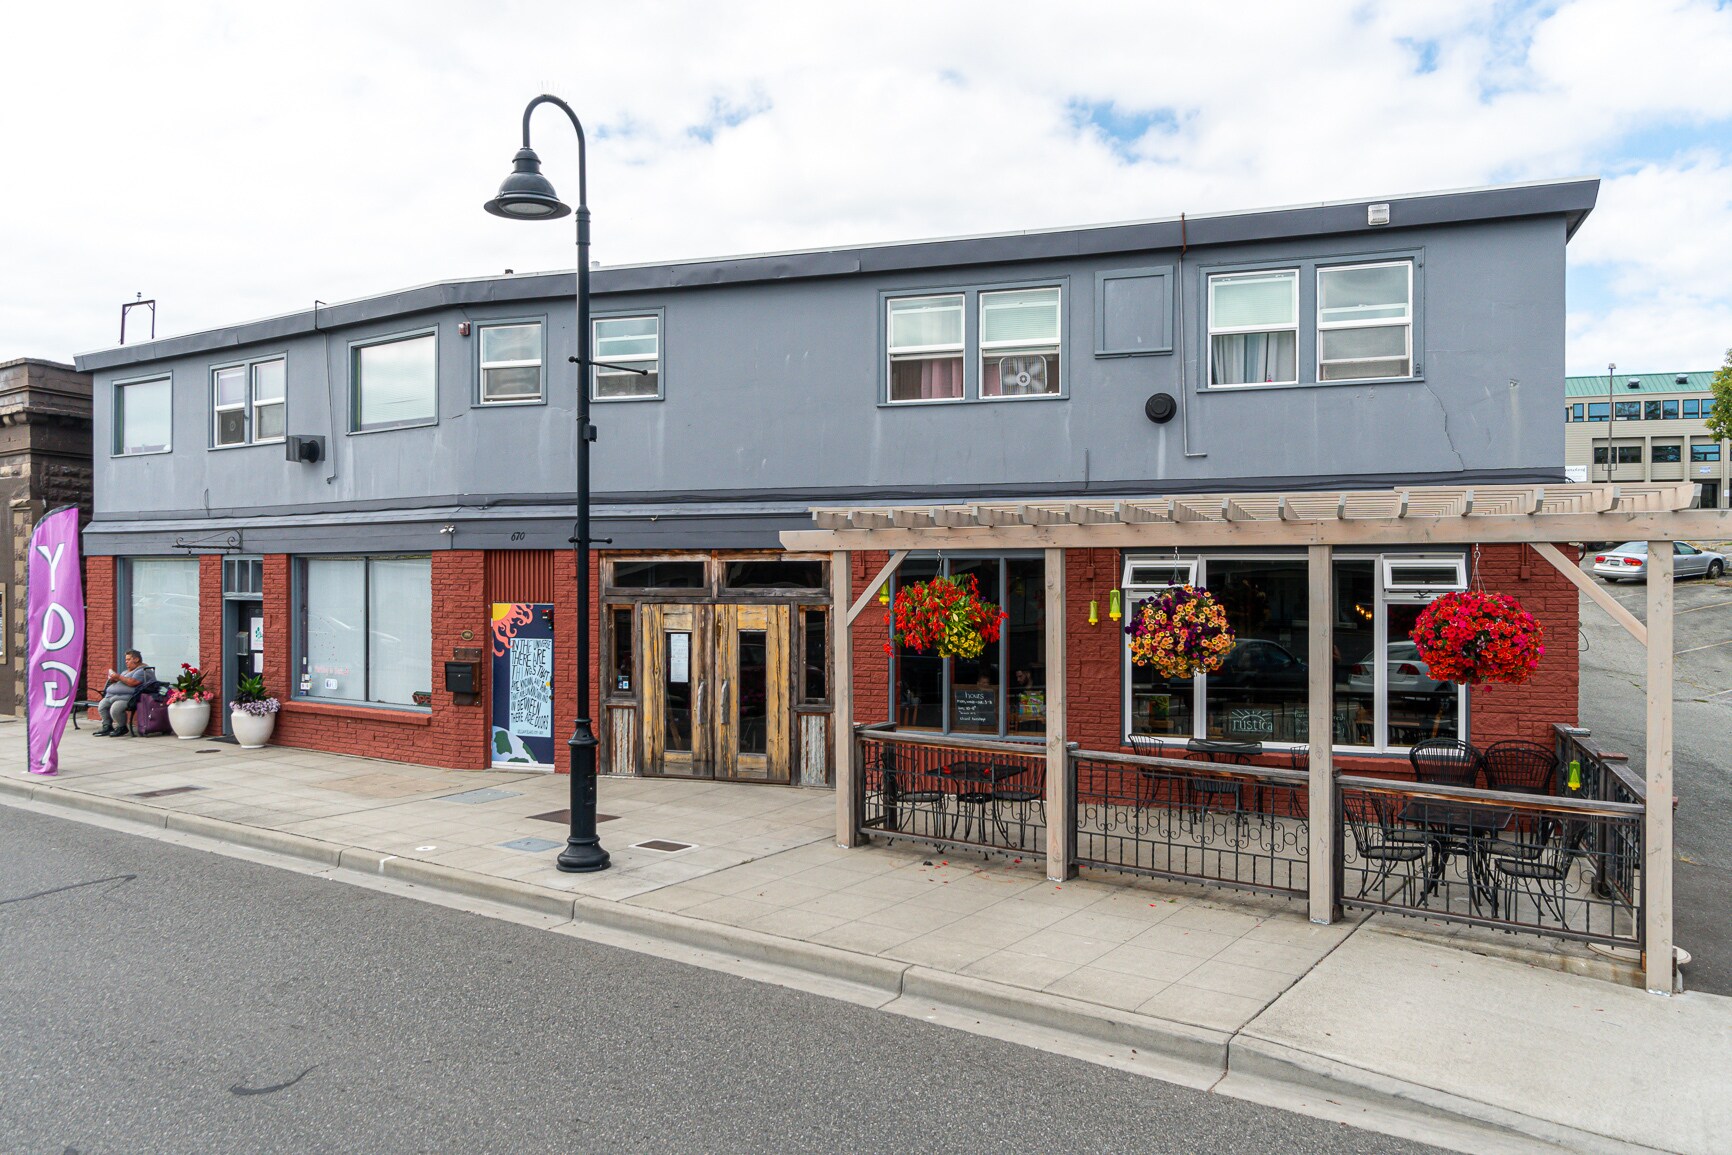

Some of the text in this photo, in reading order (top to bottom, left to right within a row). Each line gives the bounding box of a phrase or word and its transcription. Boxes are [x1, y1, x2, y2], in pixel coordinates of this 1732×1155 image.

[510, 531, 526, 541] 670
[511, 648, 546, 667] THERE ARE
[511, 664, 550, 681] THINGS THAT
[965, 691, 984, 699] hours
[517, 697, 542, 715] BETWEEN
[511, 712, 524, 723] THERE
[1232, 719, 1273, 732] rustica
